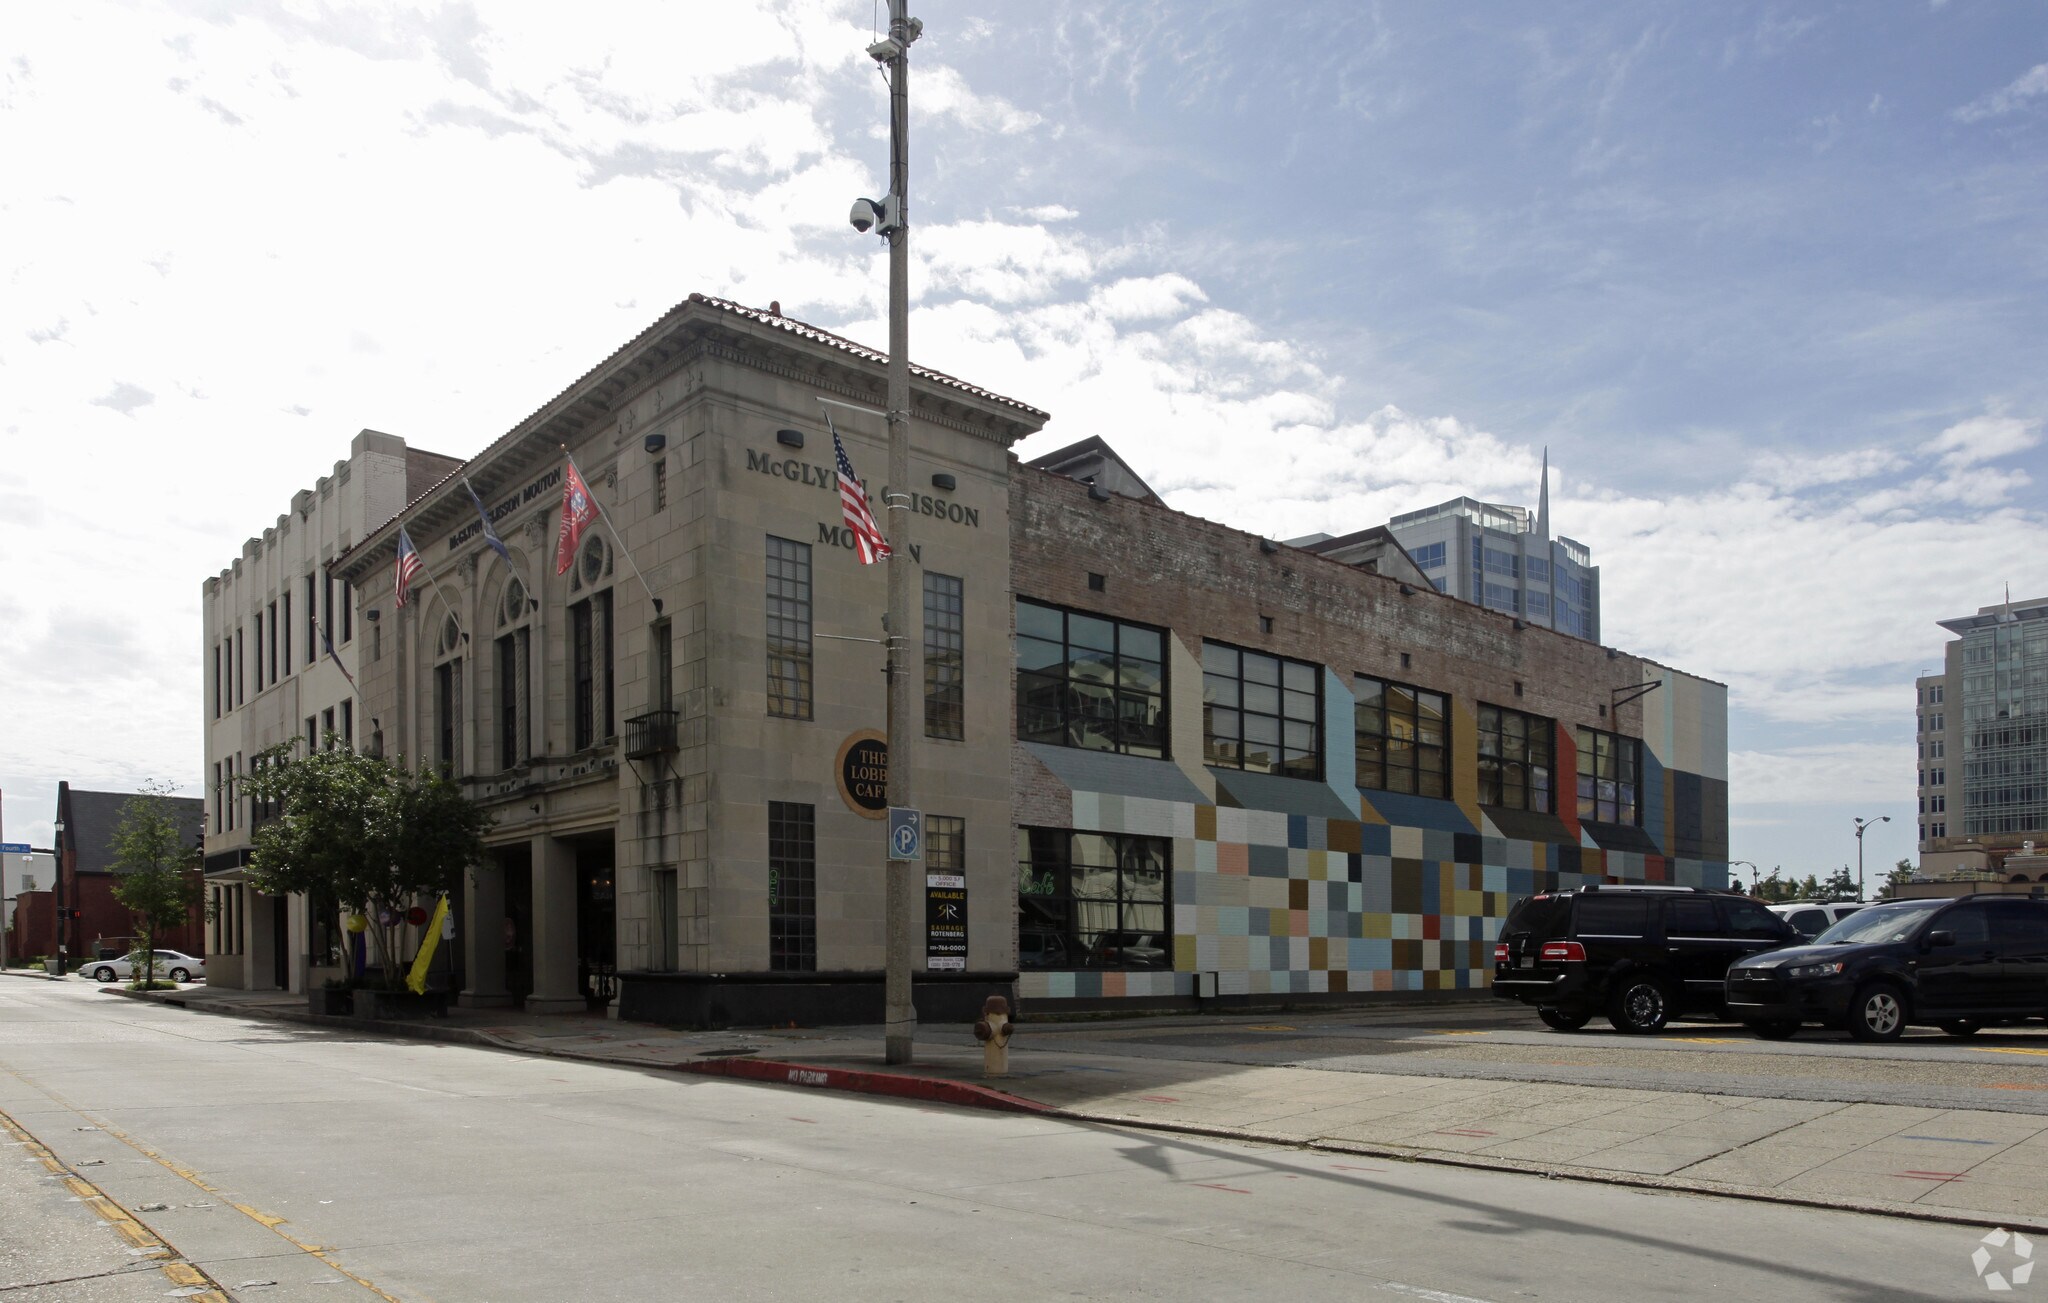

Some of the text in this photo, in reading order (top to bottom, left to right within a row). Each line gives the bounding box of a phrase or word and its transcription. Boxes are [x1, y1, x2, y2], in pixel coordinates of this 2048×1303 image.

[523, 466, 561, 504] MOUTON
[881, 484, 979, 528] GISSON
[817, 521, 921, 565] MON
[859, 749, 888, 766] THE
[851, 765, 888, 782] LOBB
[900, 829, 912, 851] P
[1019, 868, 1055, 895] Café
[930, 890, 965, 900] AVAILABLE
[788, 1069, 828, 1084] NO PARKING
